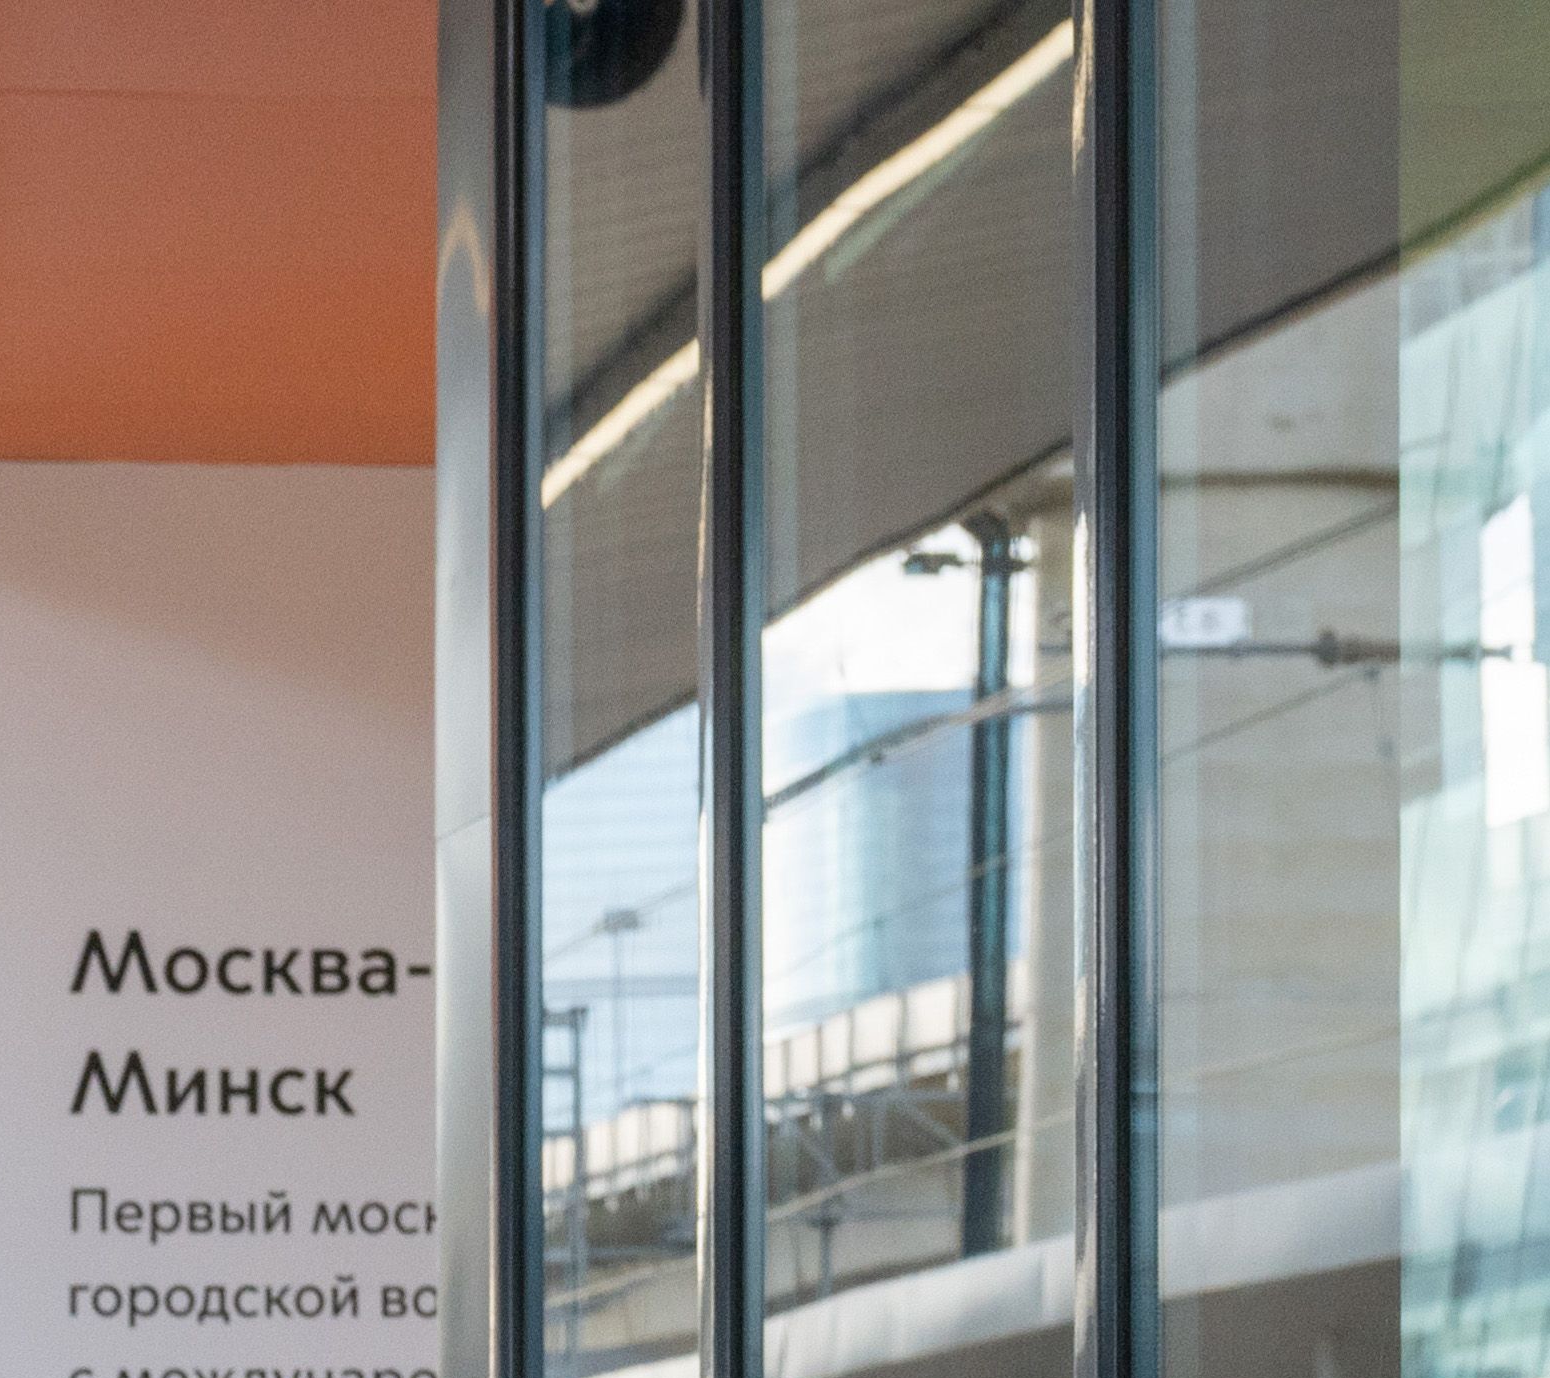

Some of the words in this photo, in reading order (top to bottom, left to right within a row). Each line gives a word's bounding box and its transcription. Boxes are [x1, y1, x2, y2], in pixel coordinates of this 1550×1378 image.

[69, 928, 434, 998] Москва-
[69, 1048, 356, 1118] Минск
[69, 1188, 292, 1245] Первый
[69, 1275, 360, 1328] городской
